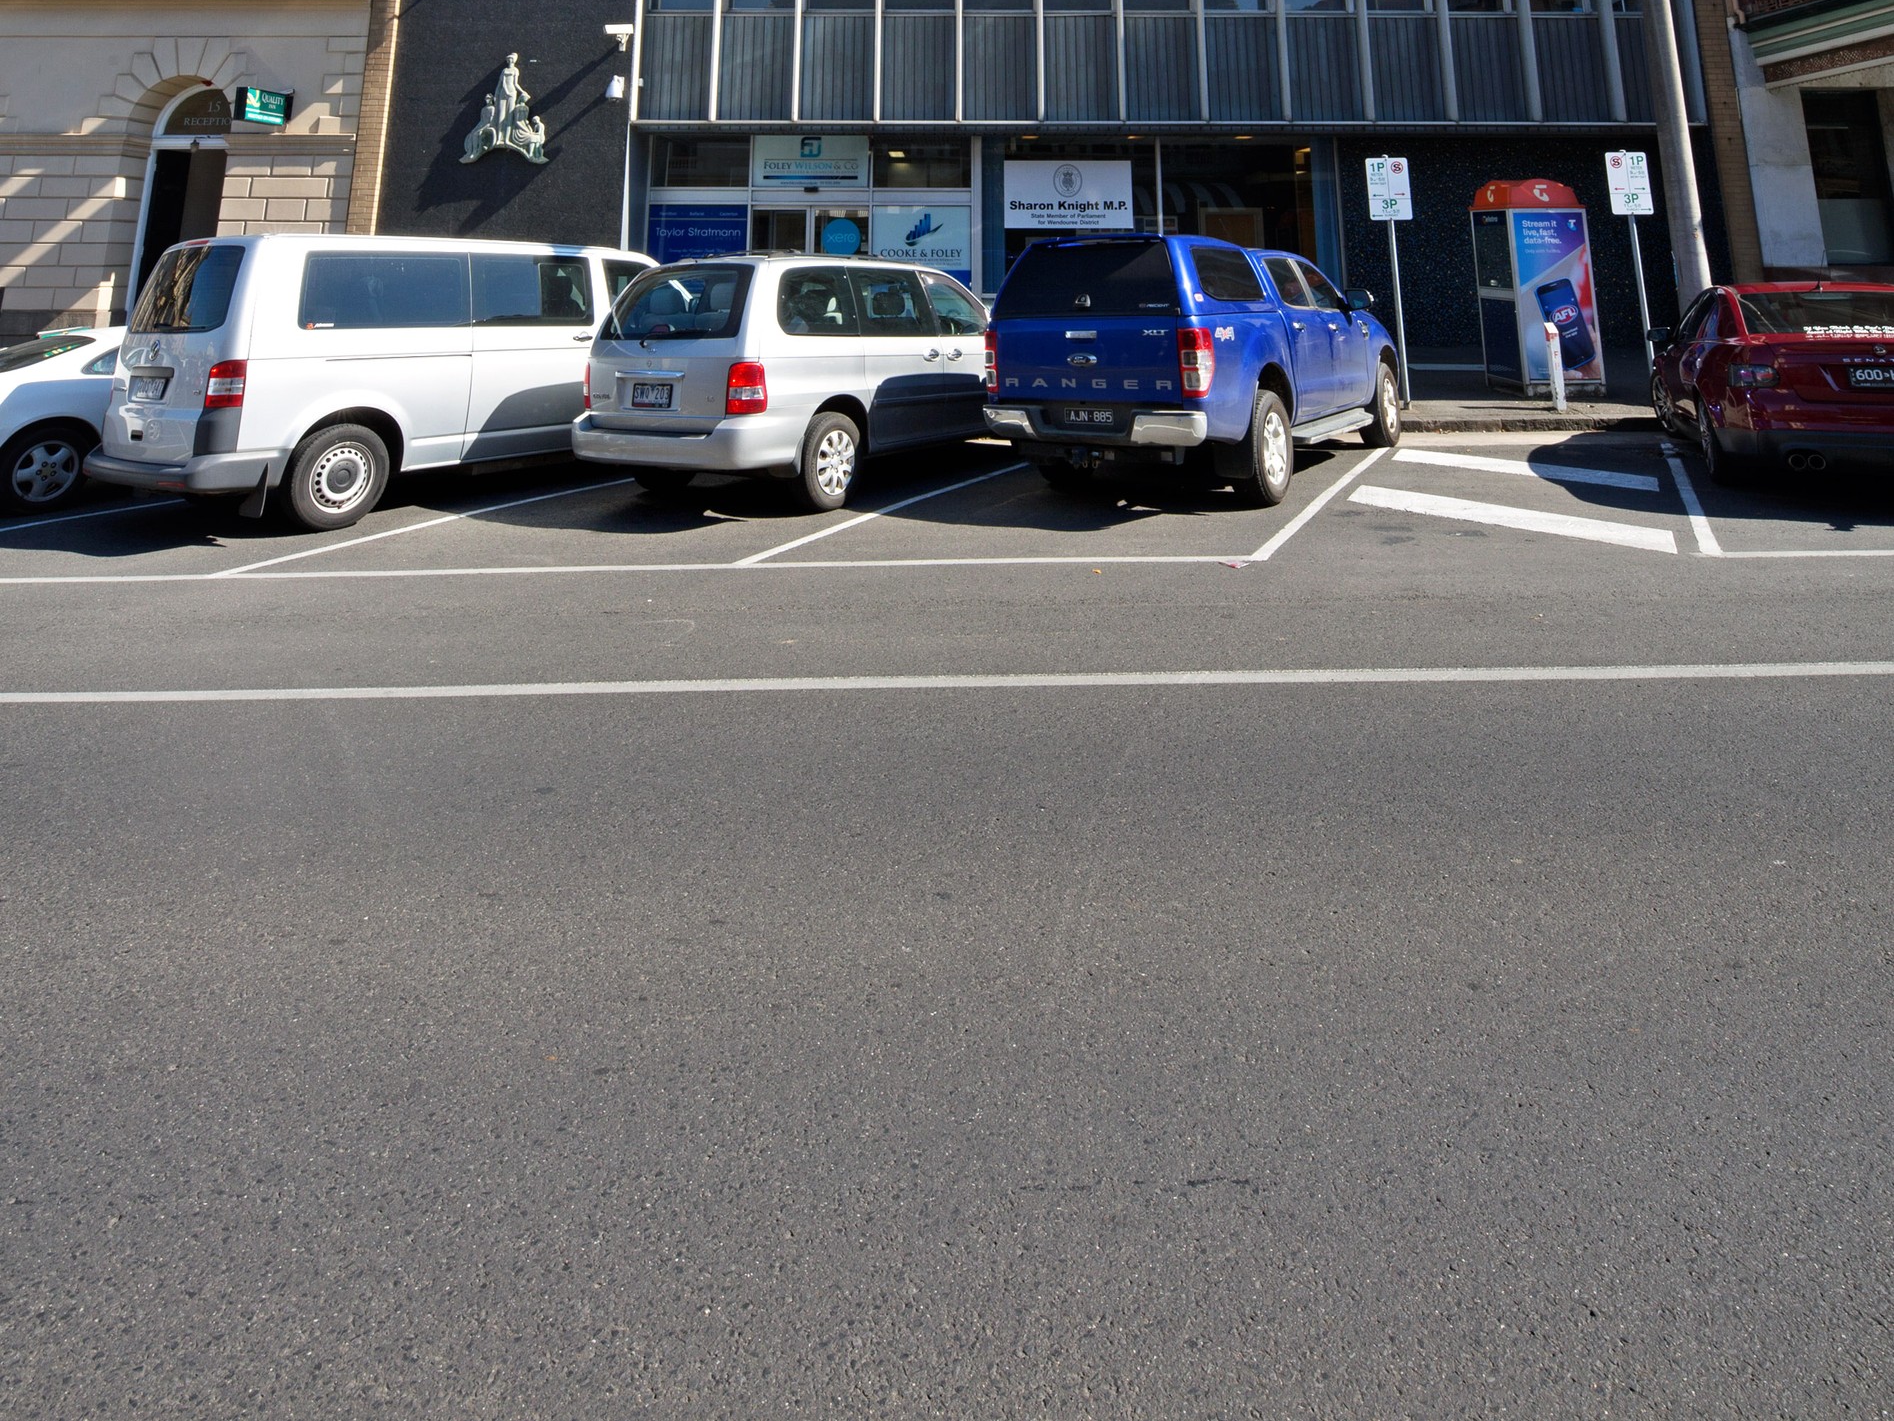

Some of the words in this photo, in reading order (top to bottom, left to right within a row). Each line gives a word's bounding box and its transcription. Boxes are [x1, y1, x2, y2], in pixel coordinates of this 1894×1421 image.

[261, 93, 284, 106] QUALITY
[208, 101, 220, 112] 15
[184, 117, 232, 126] RECEPTIO
[763, 161, 793, 170] FOLEY
[795, 161, 833, 170] WILSON
[833, 162, 841, 170] &
[1630, 155, 1644, 166] 1P
[1370, 162, 1384, 172] 1P
[1624, 193, 1639, 204] 3P
[1009, 201, 1054, 211] Sharon
[1058, 200, 1100, 213] Knight
[1103, 201, 1128, 211] M.P.
[1382, 199, 1397, 209] 3P
[1522, 220, 1550, 228] Stream
[656, 227, 684, 237] Taylor
[688, 227, 741, 237] Stratmann
[827, 233, 857, 243] xero
[880, 248, 917, 257] COOKE
[920, 248, 928, 257] &
[931, 248, 962, 257] FOLEY
[1554, 308, 1576, 323] AFL
[1005, 378, 1172, 391] RANGER
[655, 387, 670, 400] 203
